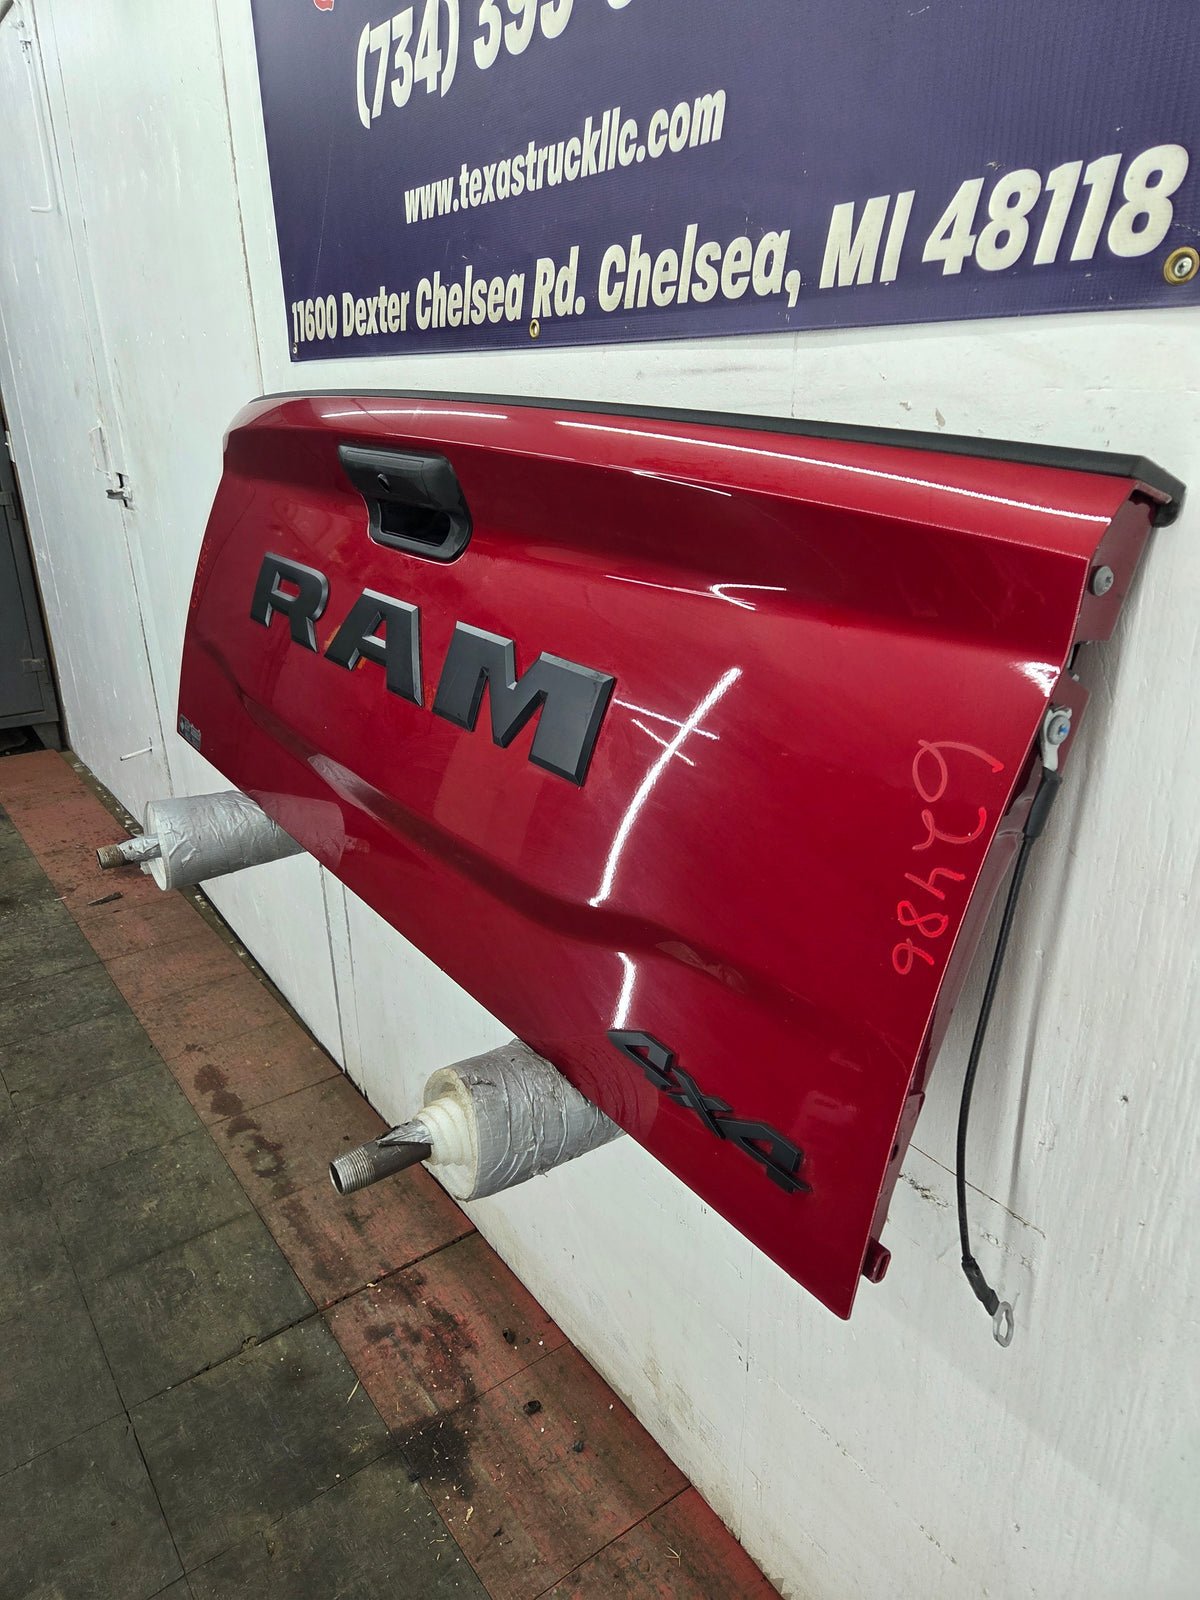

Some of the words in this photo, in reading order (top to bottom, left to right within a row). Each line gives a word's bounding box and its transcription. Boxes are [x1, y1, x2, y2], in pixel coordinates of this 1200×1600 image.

[356, 0, 460, 129] (734)
[404, 89, 727, 225] www.texastruckllc.com
[291, 294, 338, 343] 11600
[342, 286, 410, 338] Dexter
[415, 264, 526, 330] Chelsea
[531, 245, 586, 318] Rd.
[598, 223, 801, 312] Chelsea,
[819, 190, 915, 289] MI
[921, 144, 1189, 276] 48118
[250, 551, 615, 788] RAM
[892, 739, 1004, 975] 62486
